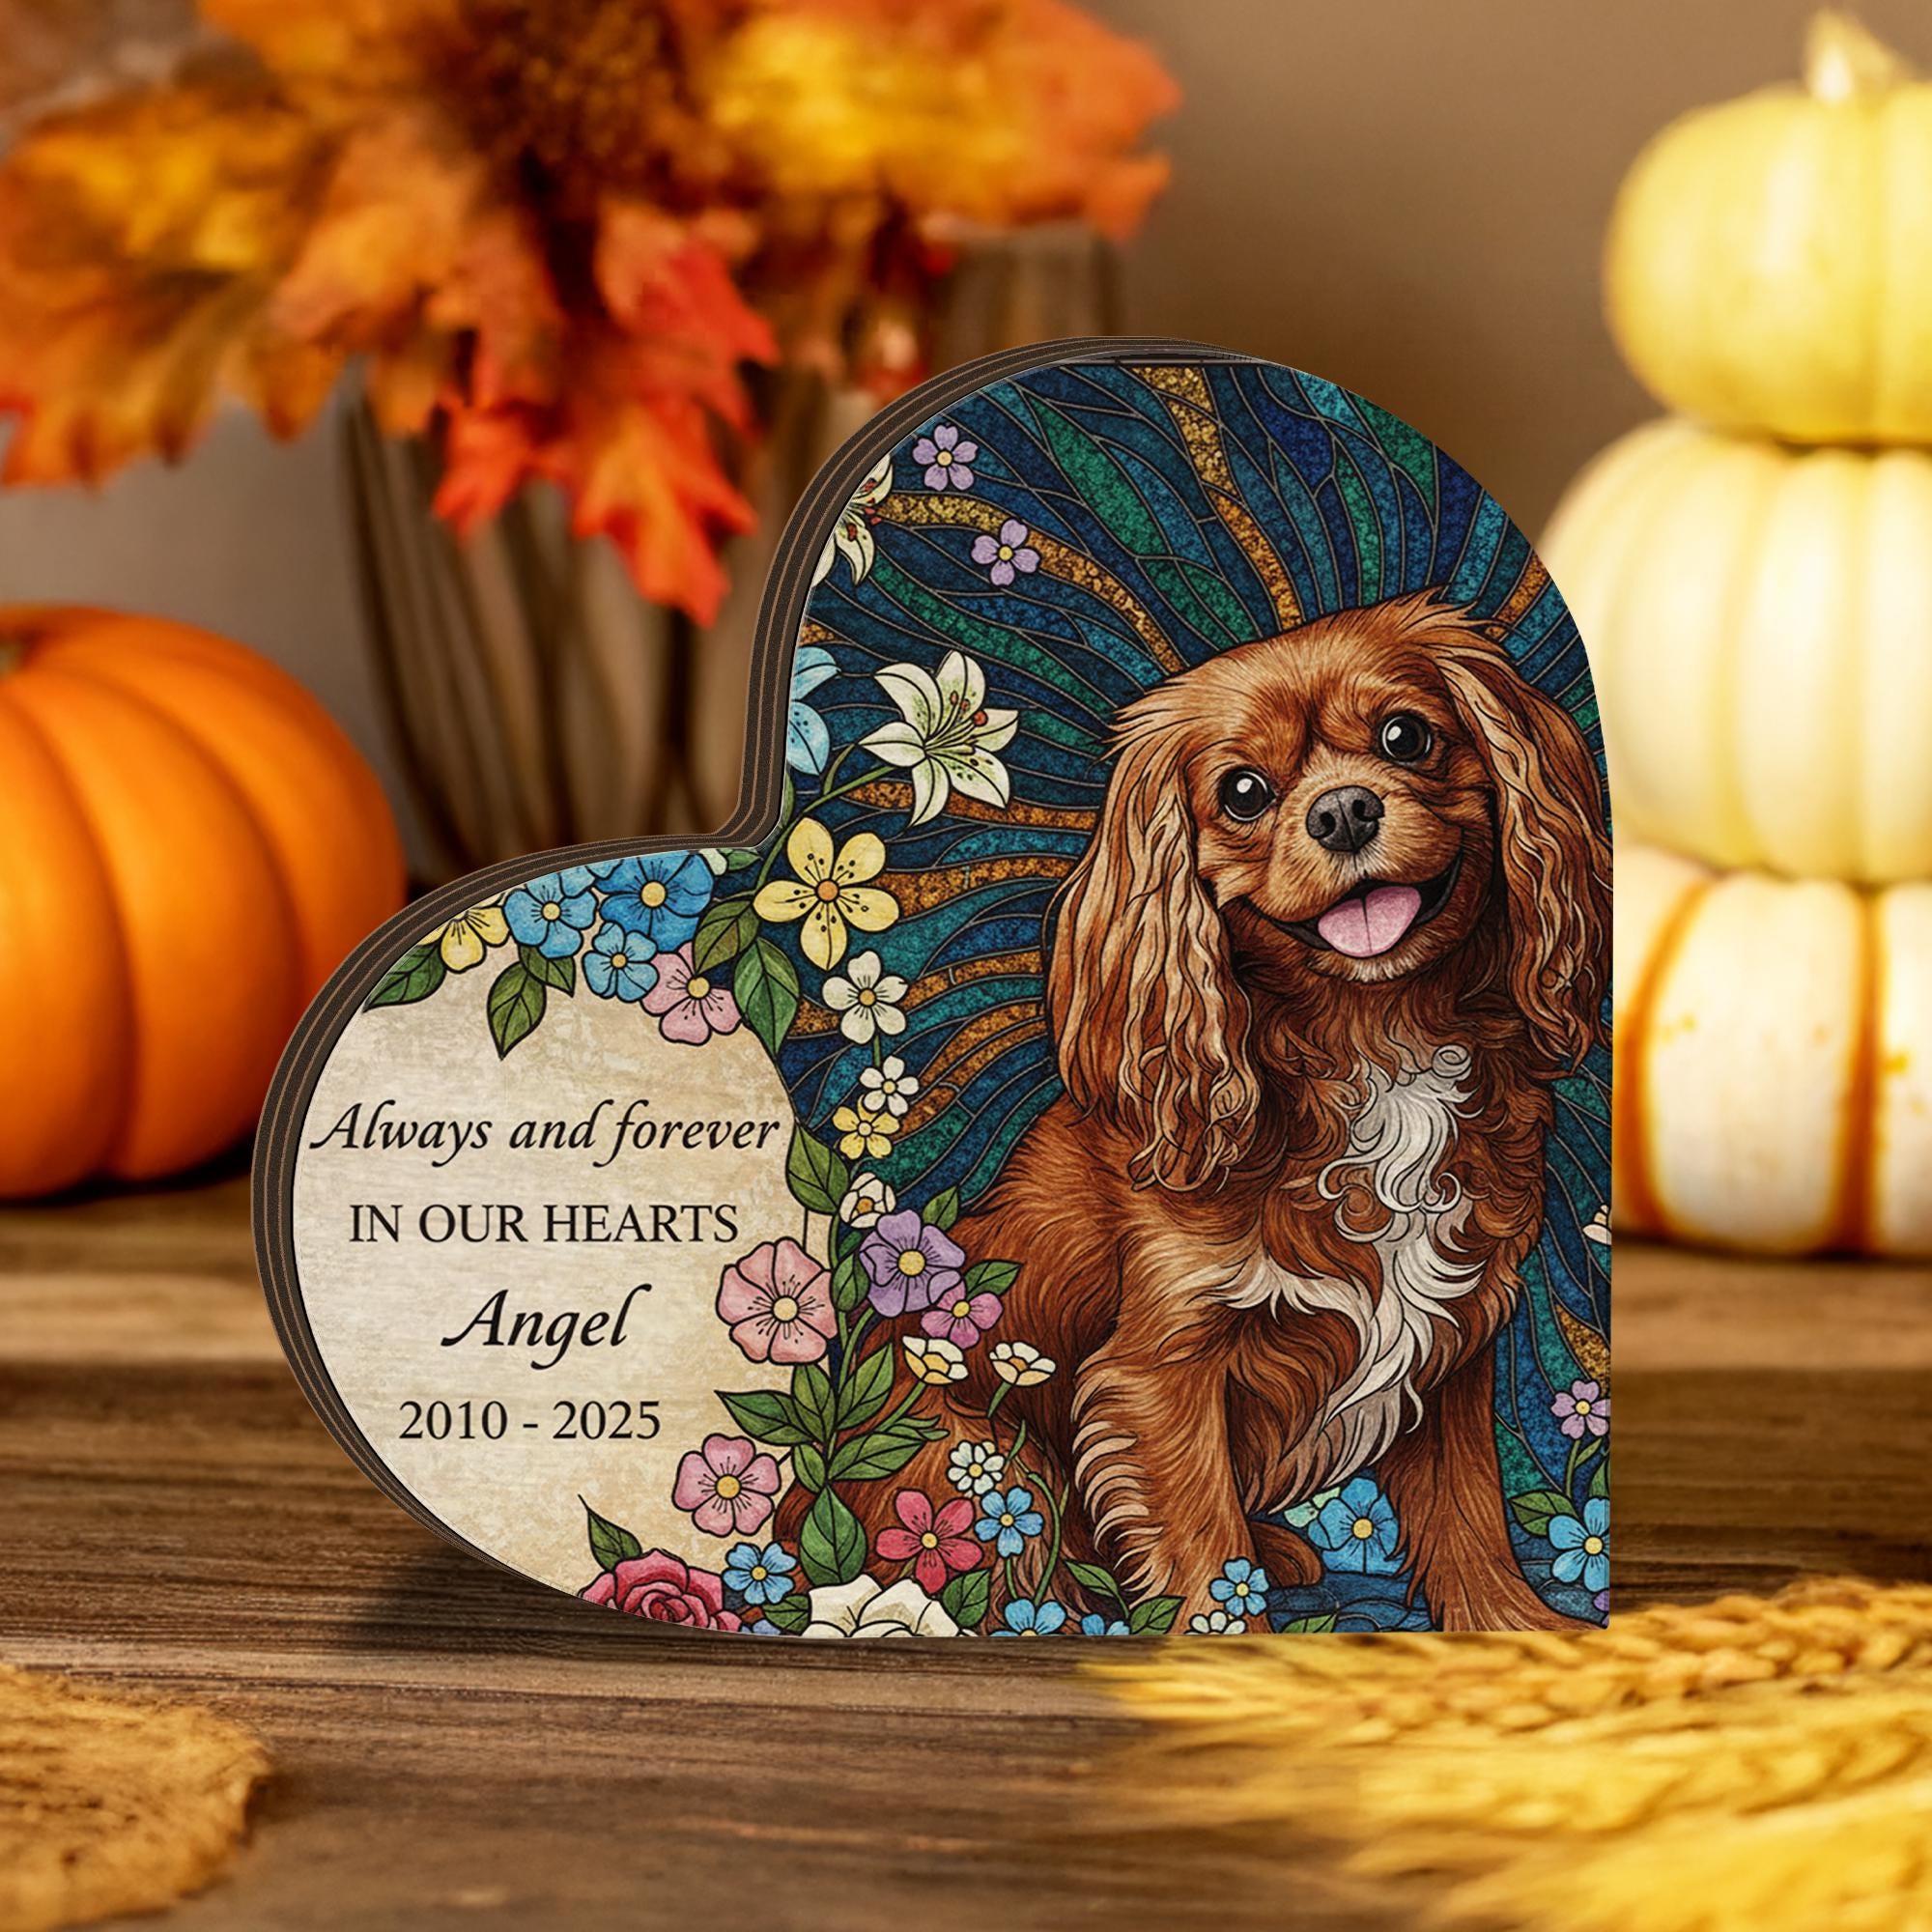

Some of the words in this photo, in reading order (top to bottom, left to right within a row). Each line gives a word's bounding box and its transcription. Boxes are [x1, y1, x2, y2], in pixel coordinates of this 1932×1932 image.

[309, 1099, 493, 1168] Always
[509, 1098, 614, 1150] and
[591, 1098, 781, 1168] forever
[349, 1204, 403, 1243] IN
[418, 1204, 528, 1243] OUR
[543, 1204, 739, 1243] HEARTS
[440, 1283, 653, 1371] Angel
[399, 1400, 508, 1440] 2010
[553, 1400, 662, 1440] 2025
